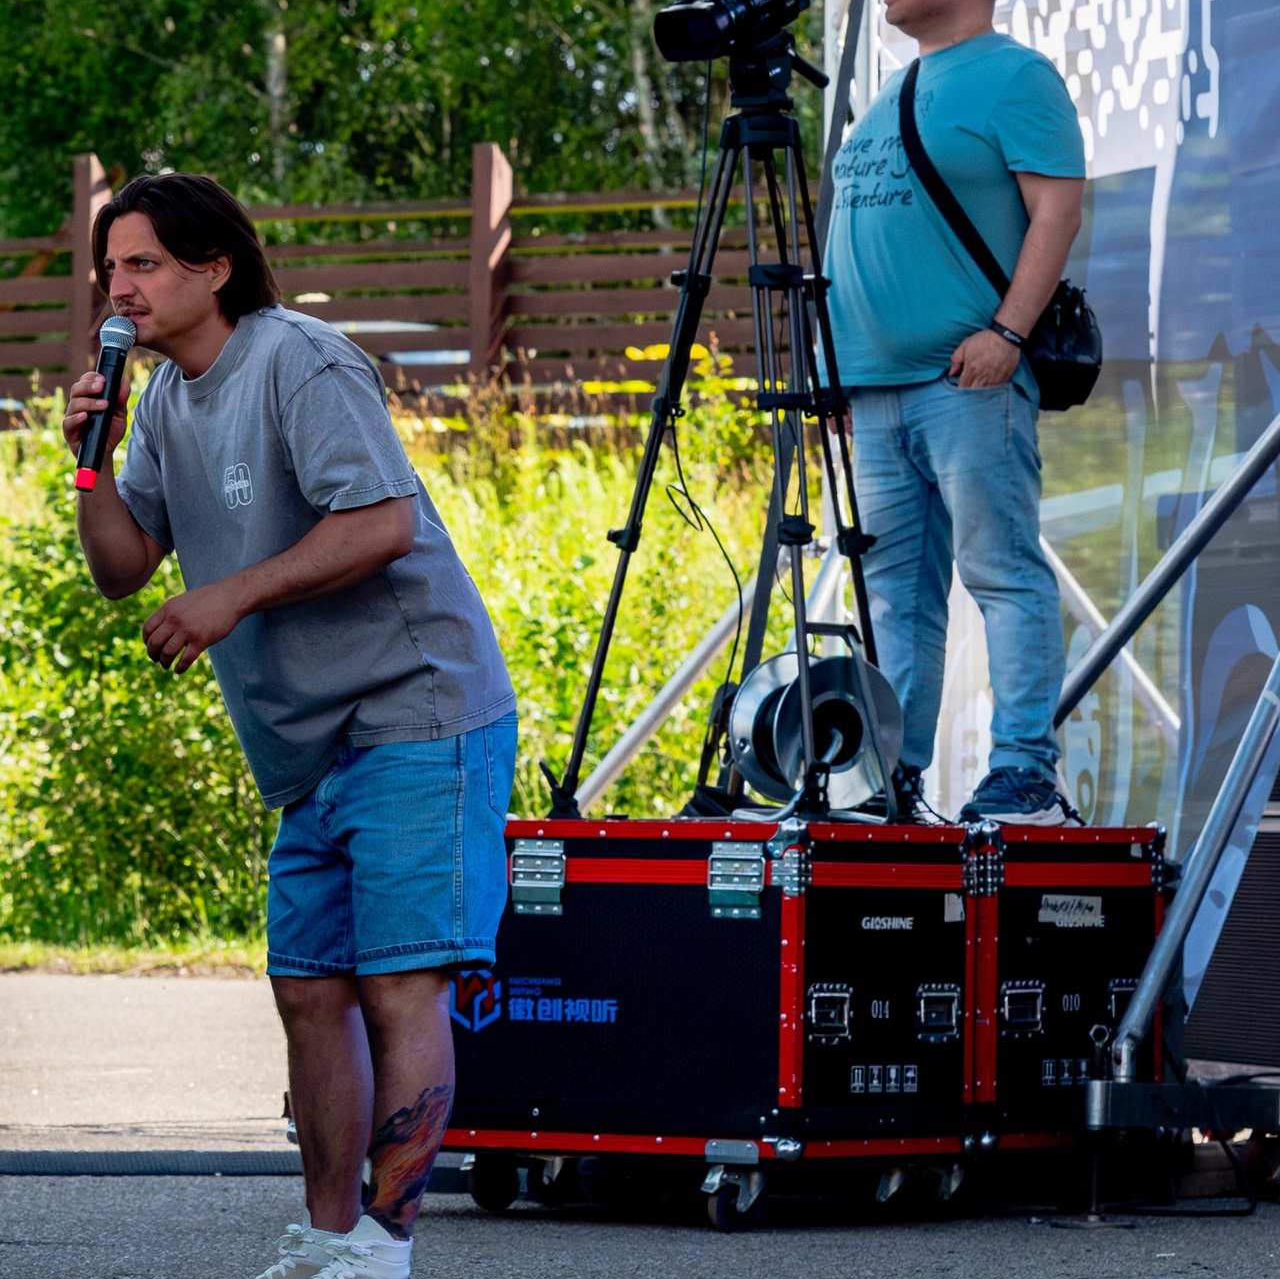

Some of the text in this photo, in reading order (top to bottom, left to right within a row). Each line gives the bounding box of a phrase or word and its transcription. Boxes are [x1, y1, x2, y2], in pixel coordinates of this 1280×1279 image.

[840, 138, 874, 154] ave
[871, 1000, 890, 1019] 014
[1062, 993, 1081, 1012] 010
